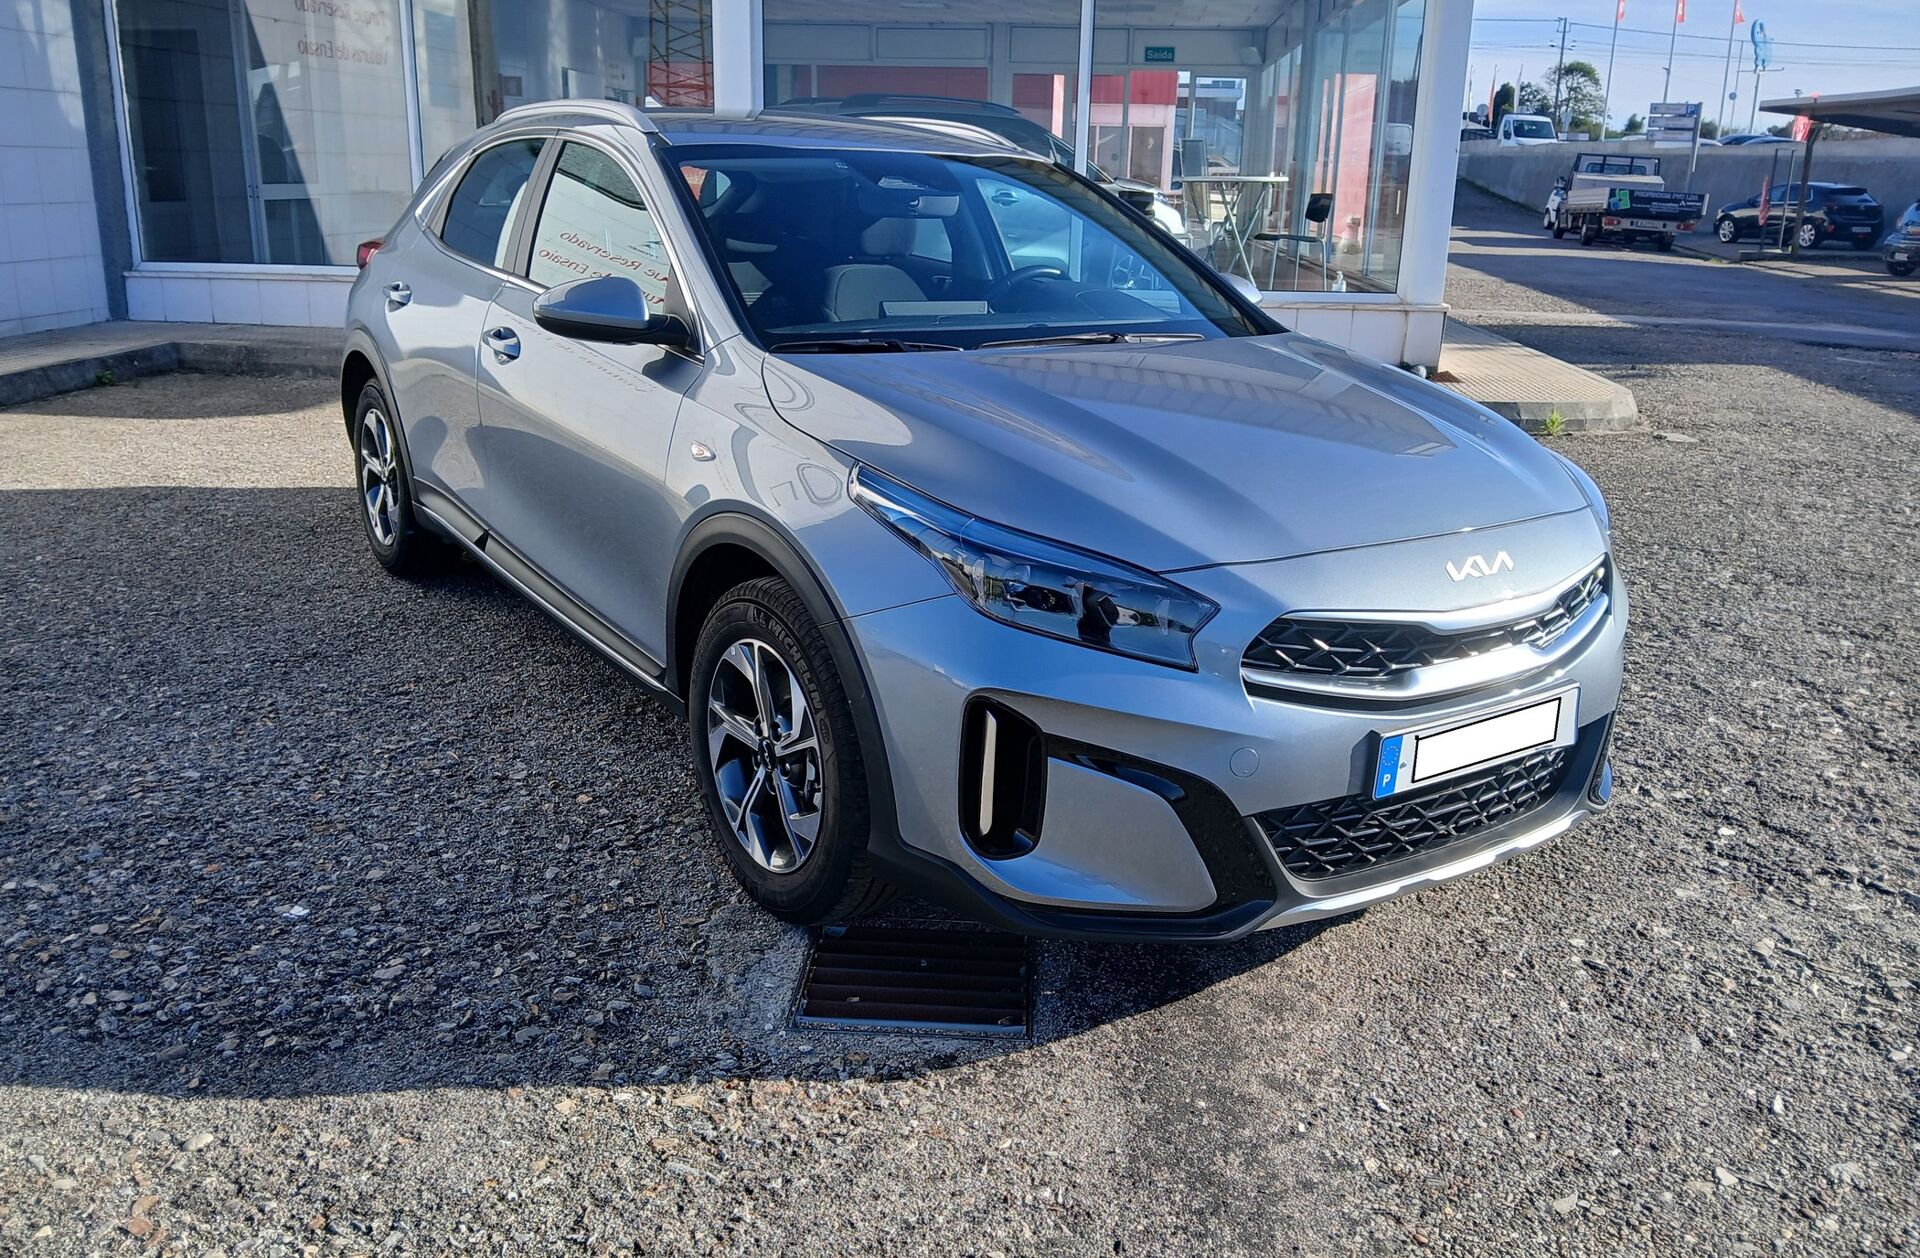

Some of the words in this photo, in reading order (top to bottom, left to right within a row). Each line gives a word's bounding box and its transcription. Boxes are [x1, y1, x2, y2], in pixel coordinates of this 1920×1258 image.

[1445, 550, 1514, 582] KIA
[768, 619, 823, 712] MICHELIN
[1382, 774, 1391, 787] P
